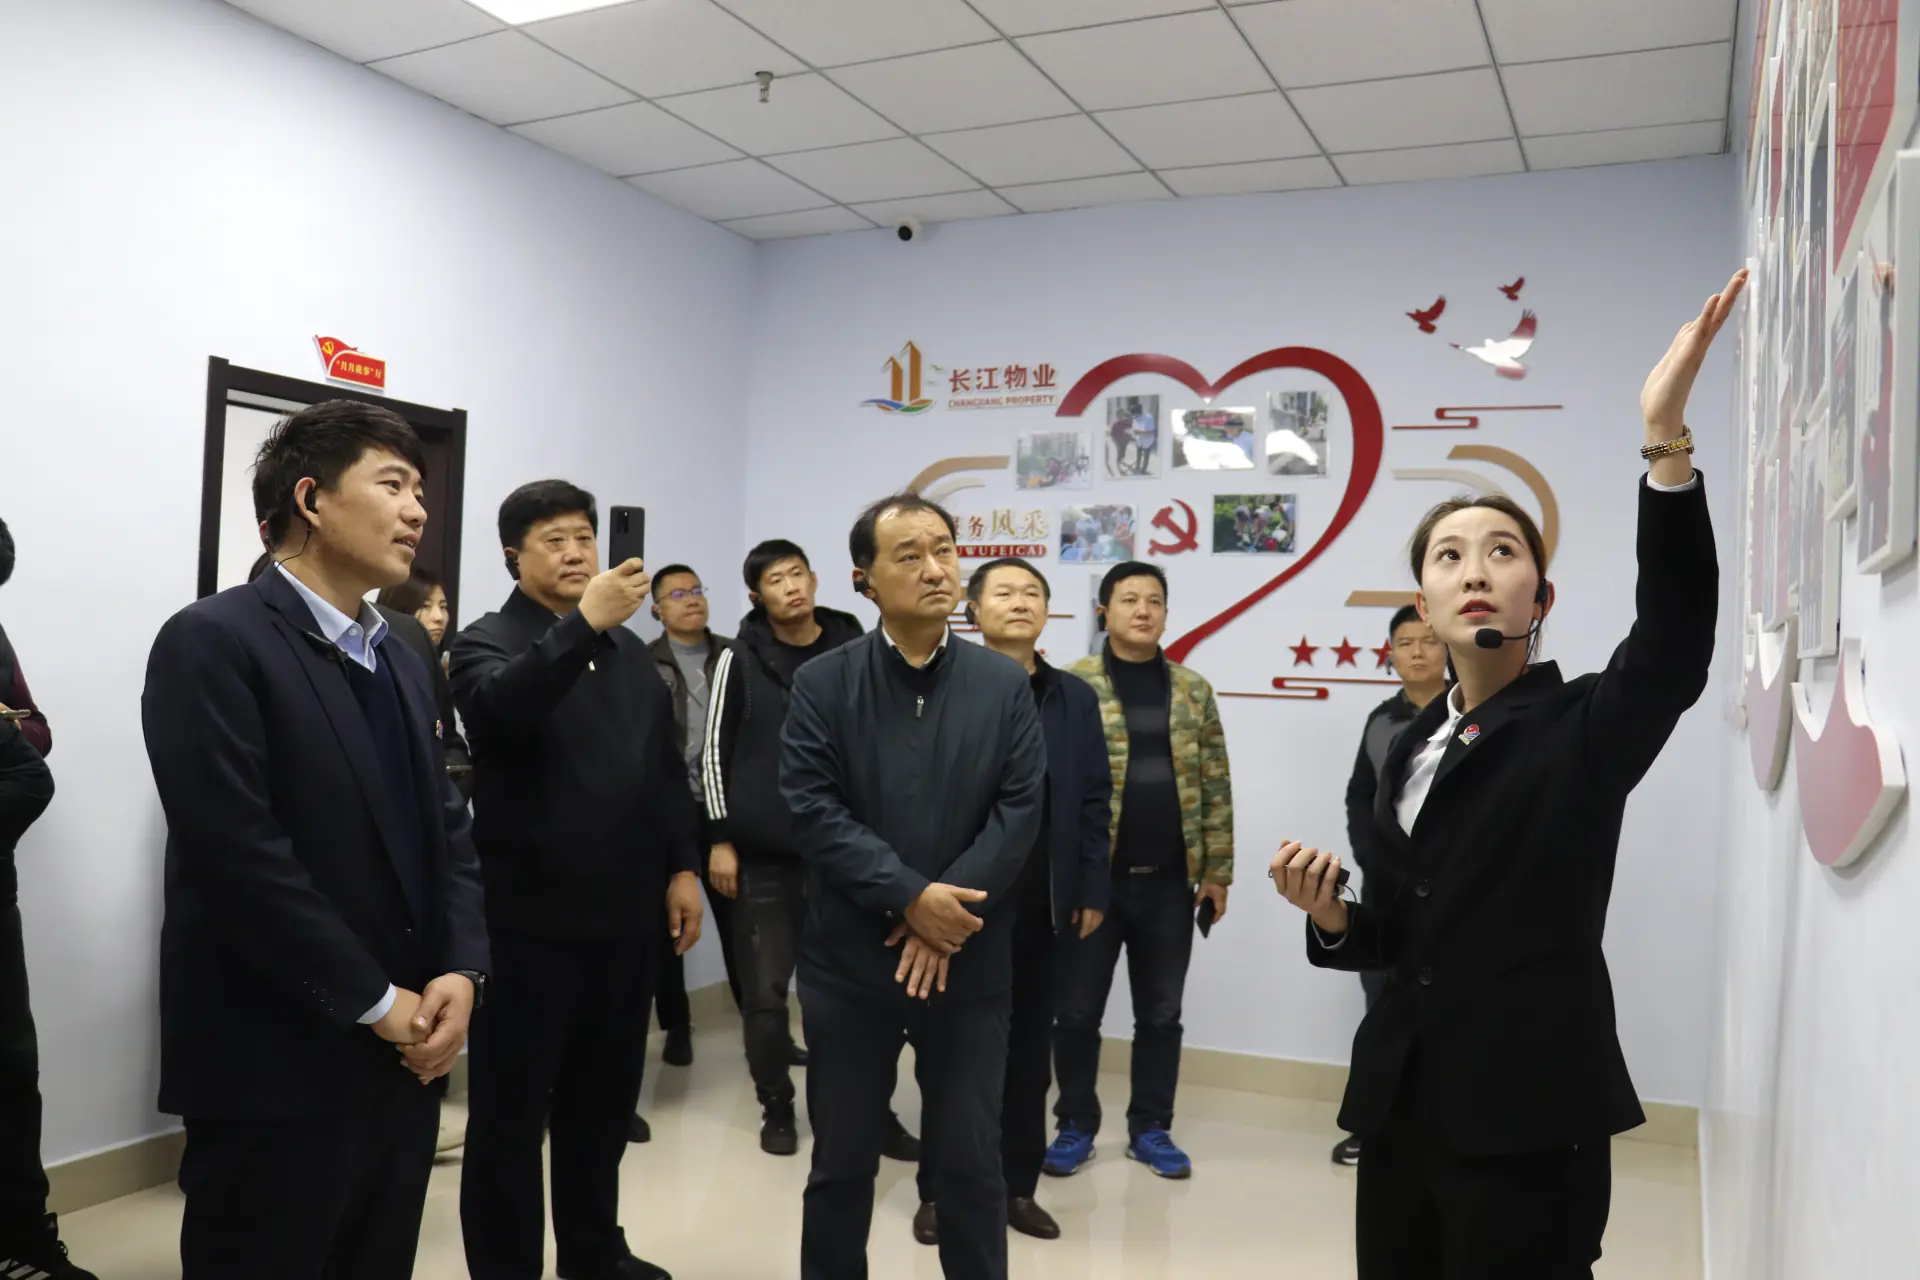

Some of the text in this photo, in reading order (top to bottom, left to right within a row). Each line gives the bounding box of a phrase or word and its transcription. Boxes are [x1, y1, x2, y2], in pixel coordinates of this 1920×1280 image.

[949, 363, 1056, 393] 长江物业
[1005, 395, 1055, 405] PROPERTY
